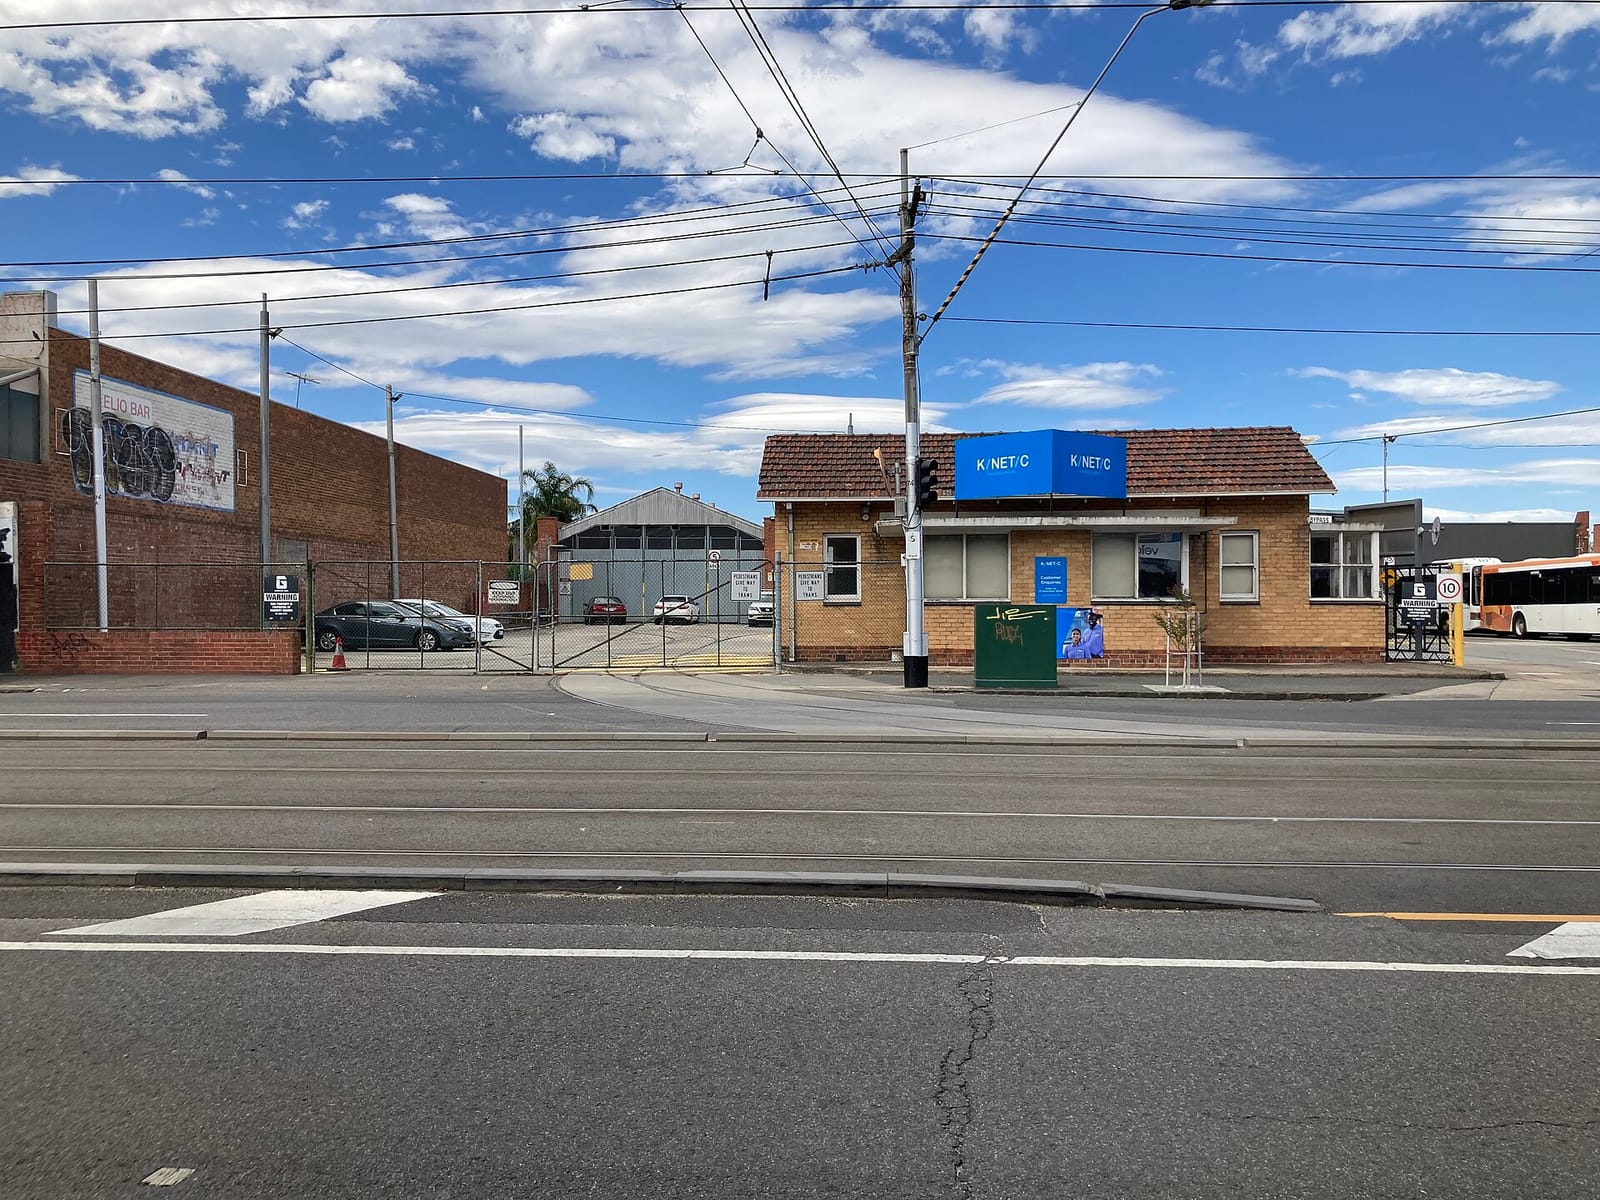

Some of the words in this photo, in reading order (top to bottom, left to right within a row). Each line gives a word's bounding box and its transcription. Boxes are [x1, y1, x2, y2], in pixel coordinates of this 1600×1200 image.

[130, 402, 151, 419] BAR
[1442, 583, 1456, 594] 10
[265, 593, 298, 601] WARNING
